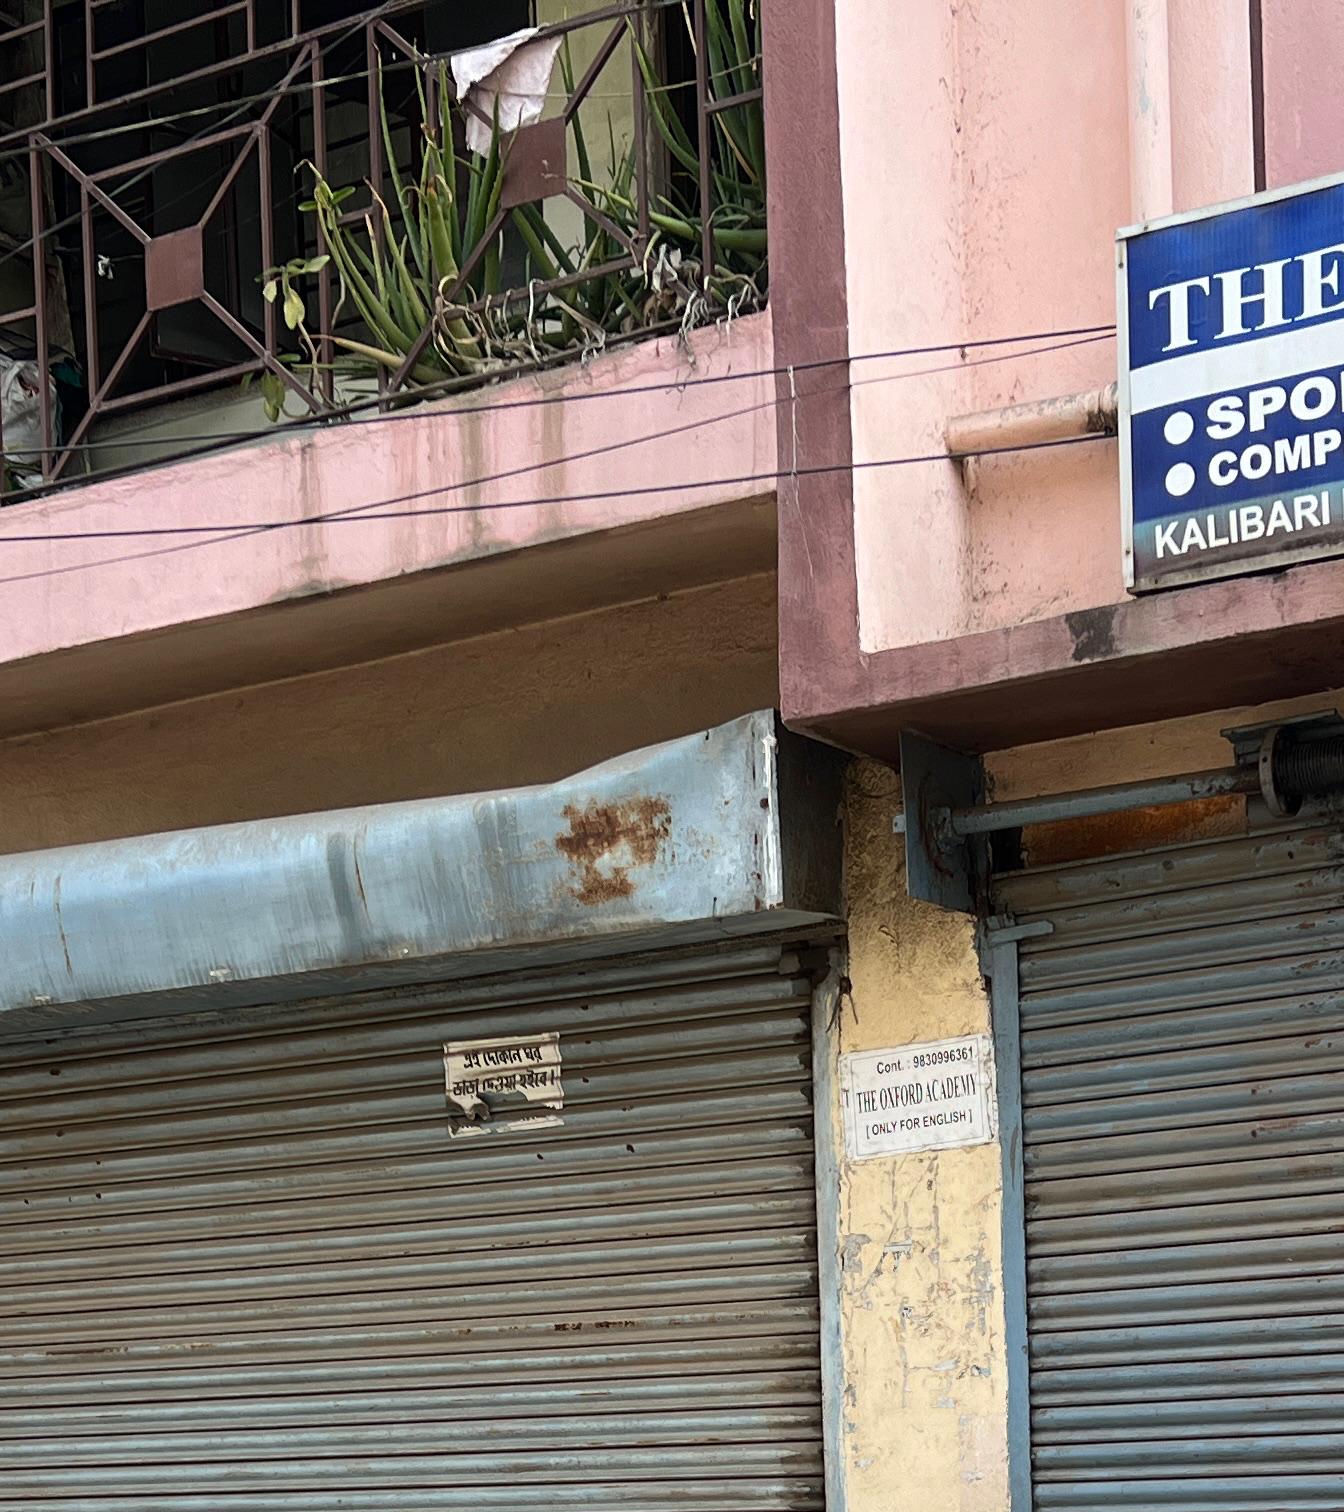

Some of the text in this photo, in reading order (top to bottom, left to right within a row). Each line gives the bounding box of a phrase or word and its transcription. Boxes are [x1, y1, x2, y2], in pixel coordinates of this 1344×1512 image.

[1154, 489, 1330, 559] KALIBARI
[913, 1046, 974, 1069] 9830996361
[856, 1072, 978, 1114] THE OXFORD ACADEMY
[900, 1118, 921, 1131] FOR
